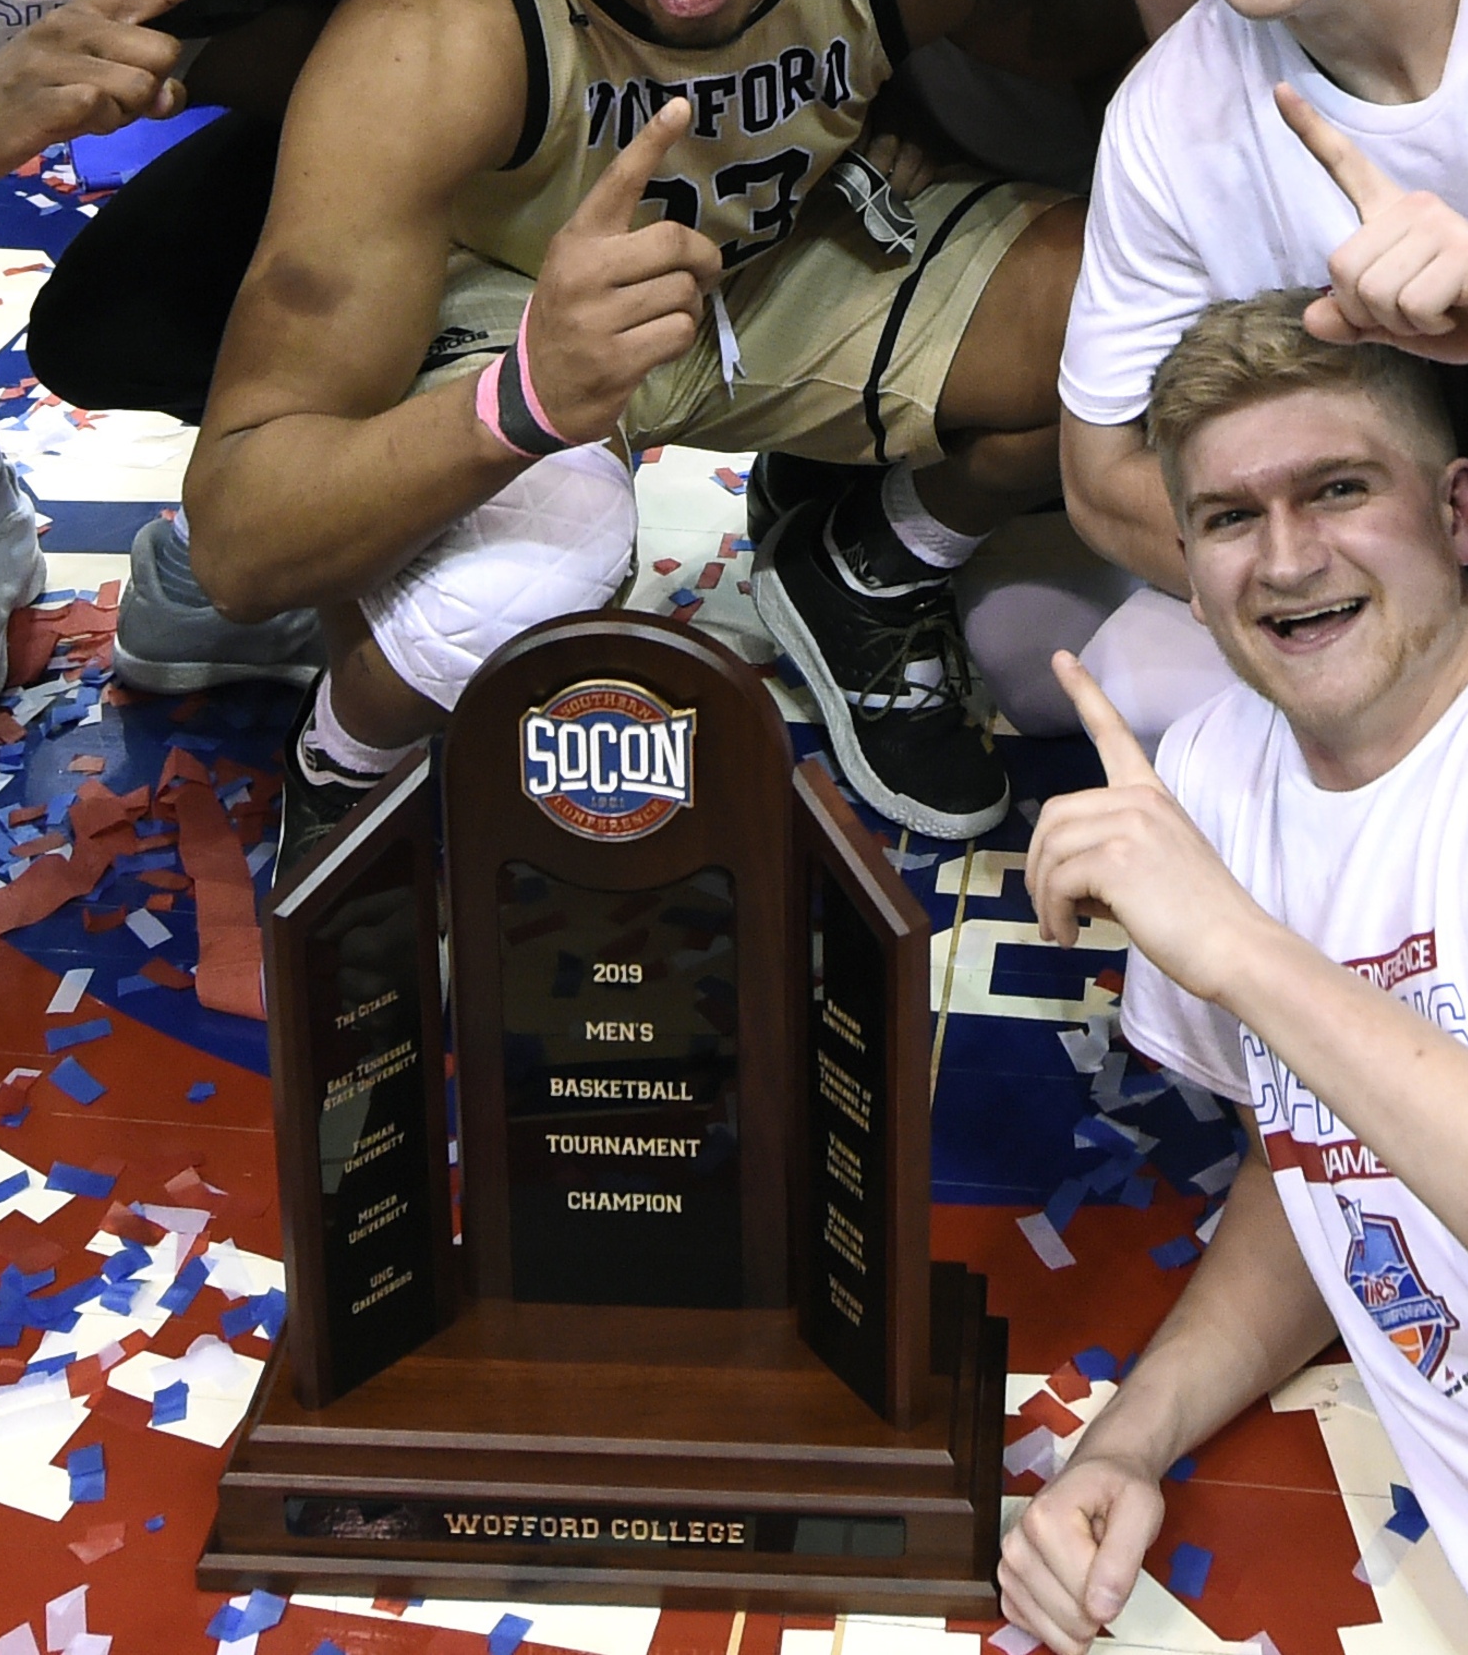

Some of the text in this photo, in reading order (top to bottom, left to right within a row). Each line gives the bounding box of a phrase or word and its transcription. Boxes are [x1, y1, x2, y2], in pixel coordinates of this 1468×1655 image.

[560, 693, 652, 720] SOUTHERN
[527, 716, 688, 798] SOCON
[553, 797, 665, 832] CONFERENCE
[592, 963, 643, 984] 2019
[585, 1021, 654, 1042] MEN'S
[549, 1078, 693, 1101] BASKETBALL
[545, 1134, 701, 1158] TOURNAMENT
[567, 1192, 682, 1213] CHAMPION
[443, 1512, 746, 1545] WOFFORD COLLEGE
